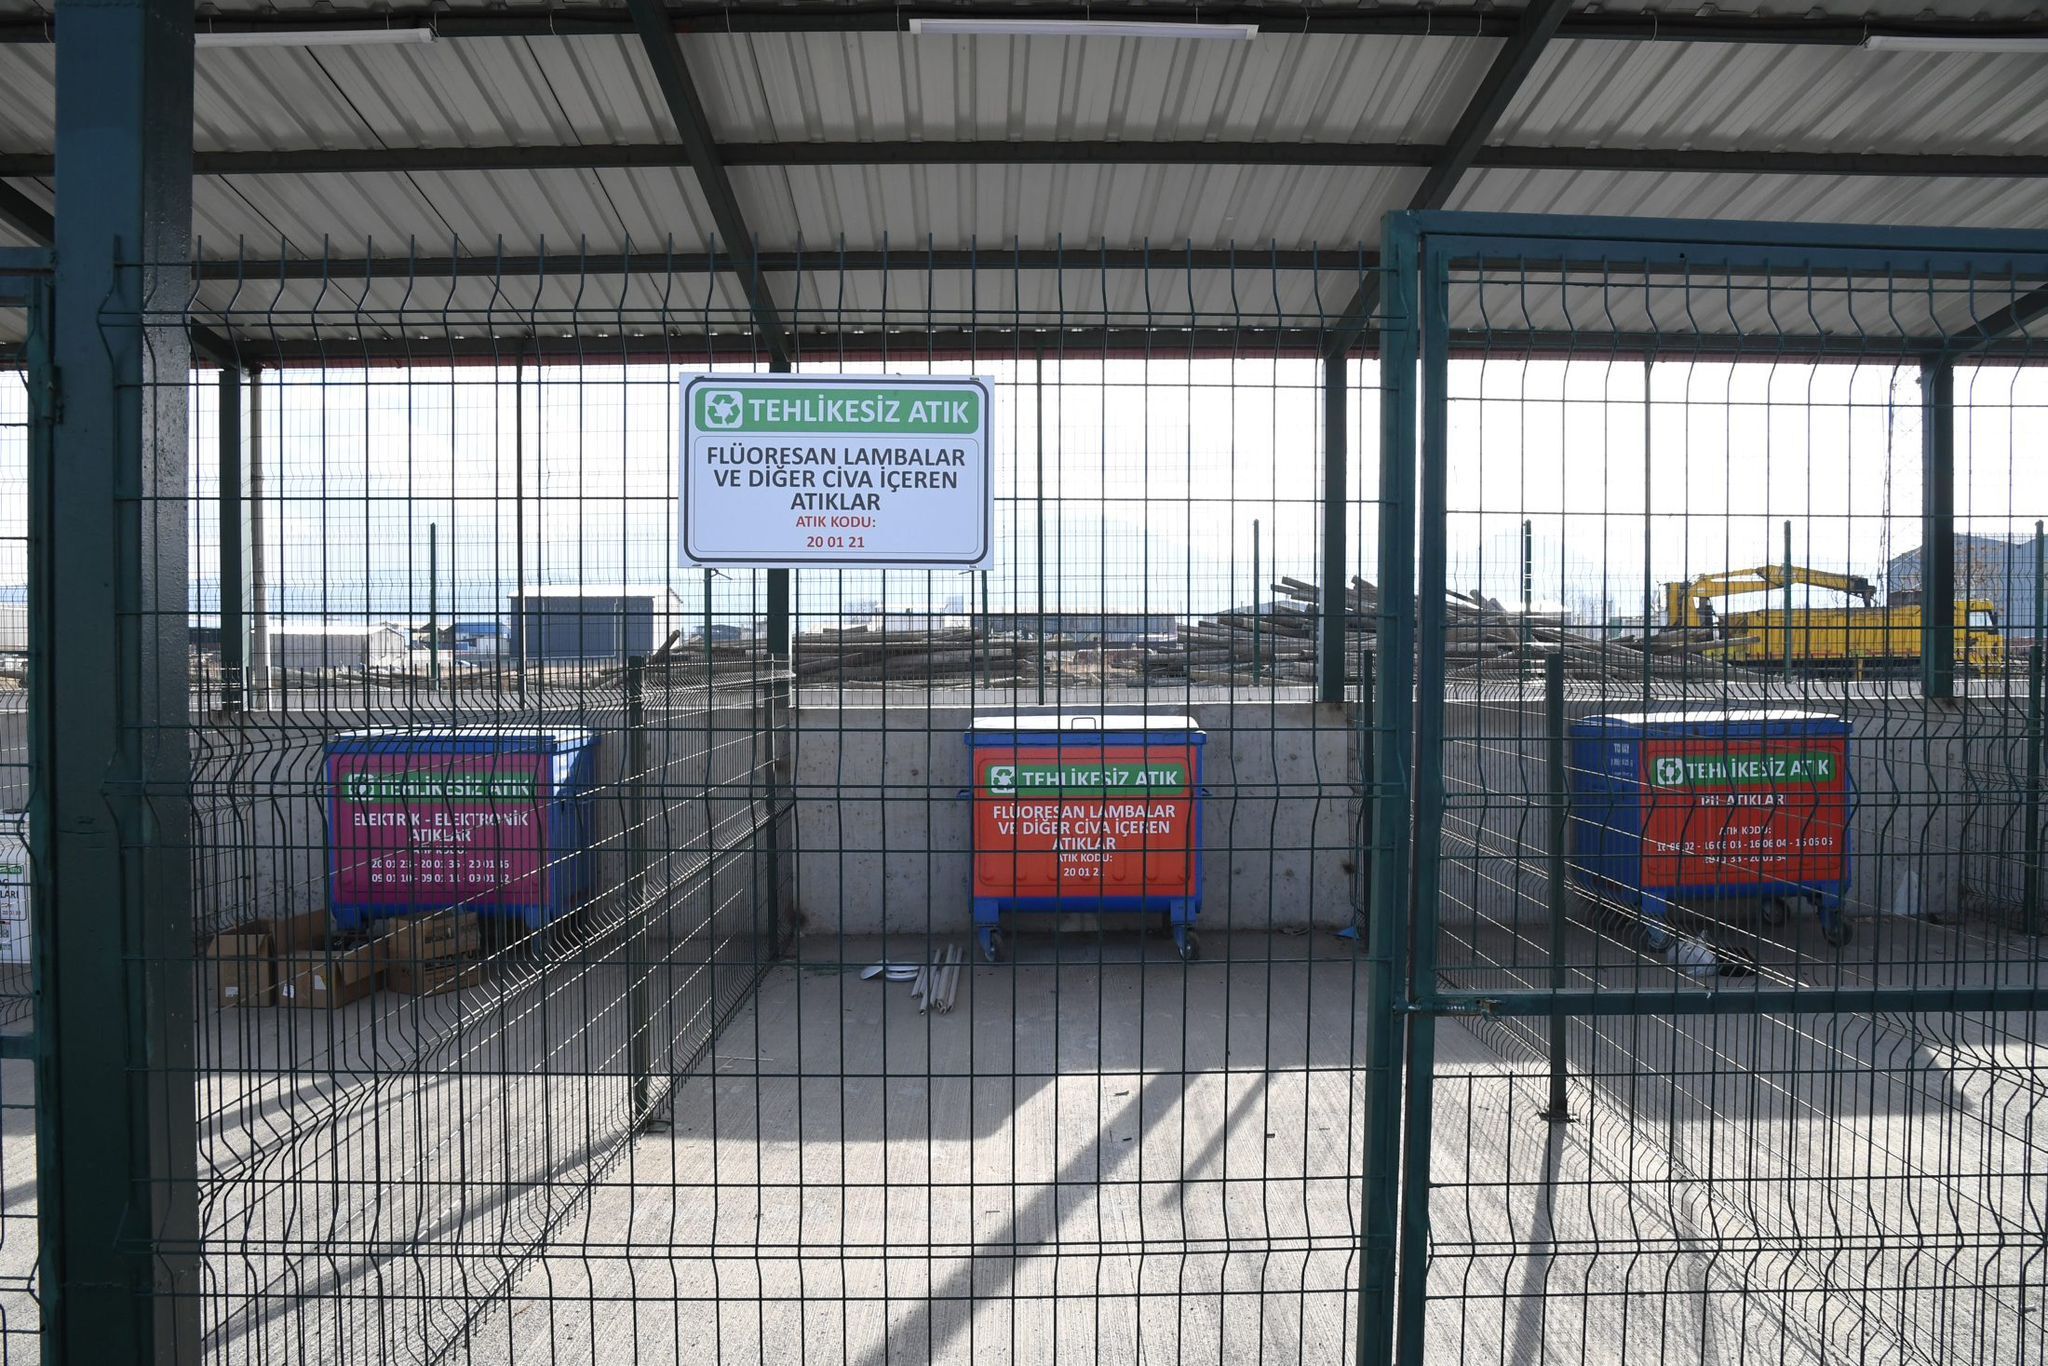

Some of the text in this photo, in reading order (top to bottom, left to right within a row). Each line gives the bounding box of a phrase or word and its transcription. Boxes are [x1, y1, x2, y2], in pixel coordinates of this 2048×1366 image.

[749, 394, 969, 423] TEHLİKESİZ ATIK
[707, 443, 966, 467] FLÜORESAN LAMBALAR
[713, 465, 958, 492] VE DİĞER CİVA İÇEREN
[790, 493, 881, 511] ATIKLAR
[795, 516, 876, 528] ATIK KODU:
[807, 536, 865, 548] 20 01 21
[1135, 771, 1178, 786] ATIK
[355, 811, 420, 827] ELEKTRK
[993, 803, 1176, 819] FLÜORESAN LAMBALAR
[998, 817, 1170, 837] VE DİĞER CİVA İÇEREN
[1052, 837, 1117, 850] ATIKLAR
[1064, 868, 1104, 877] 20 01 2
